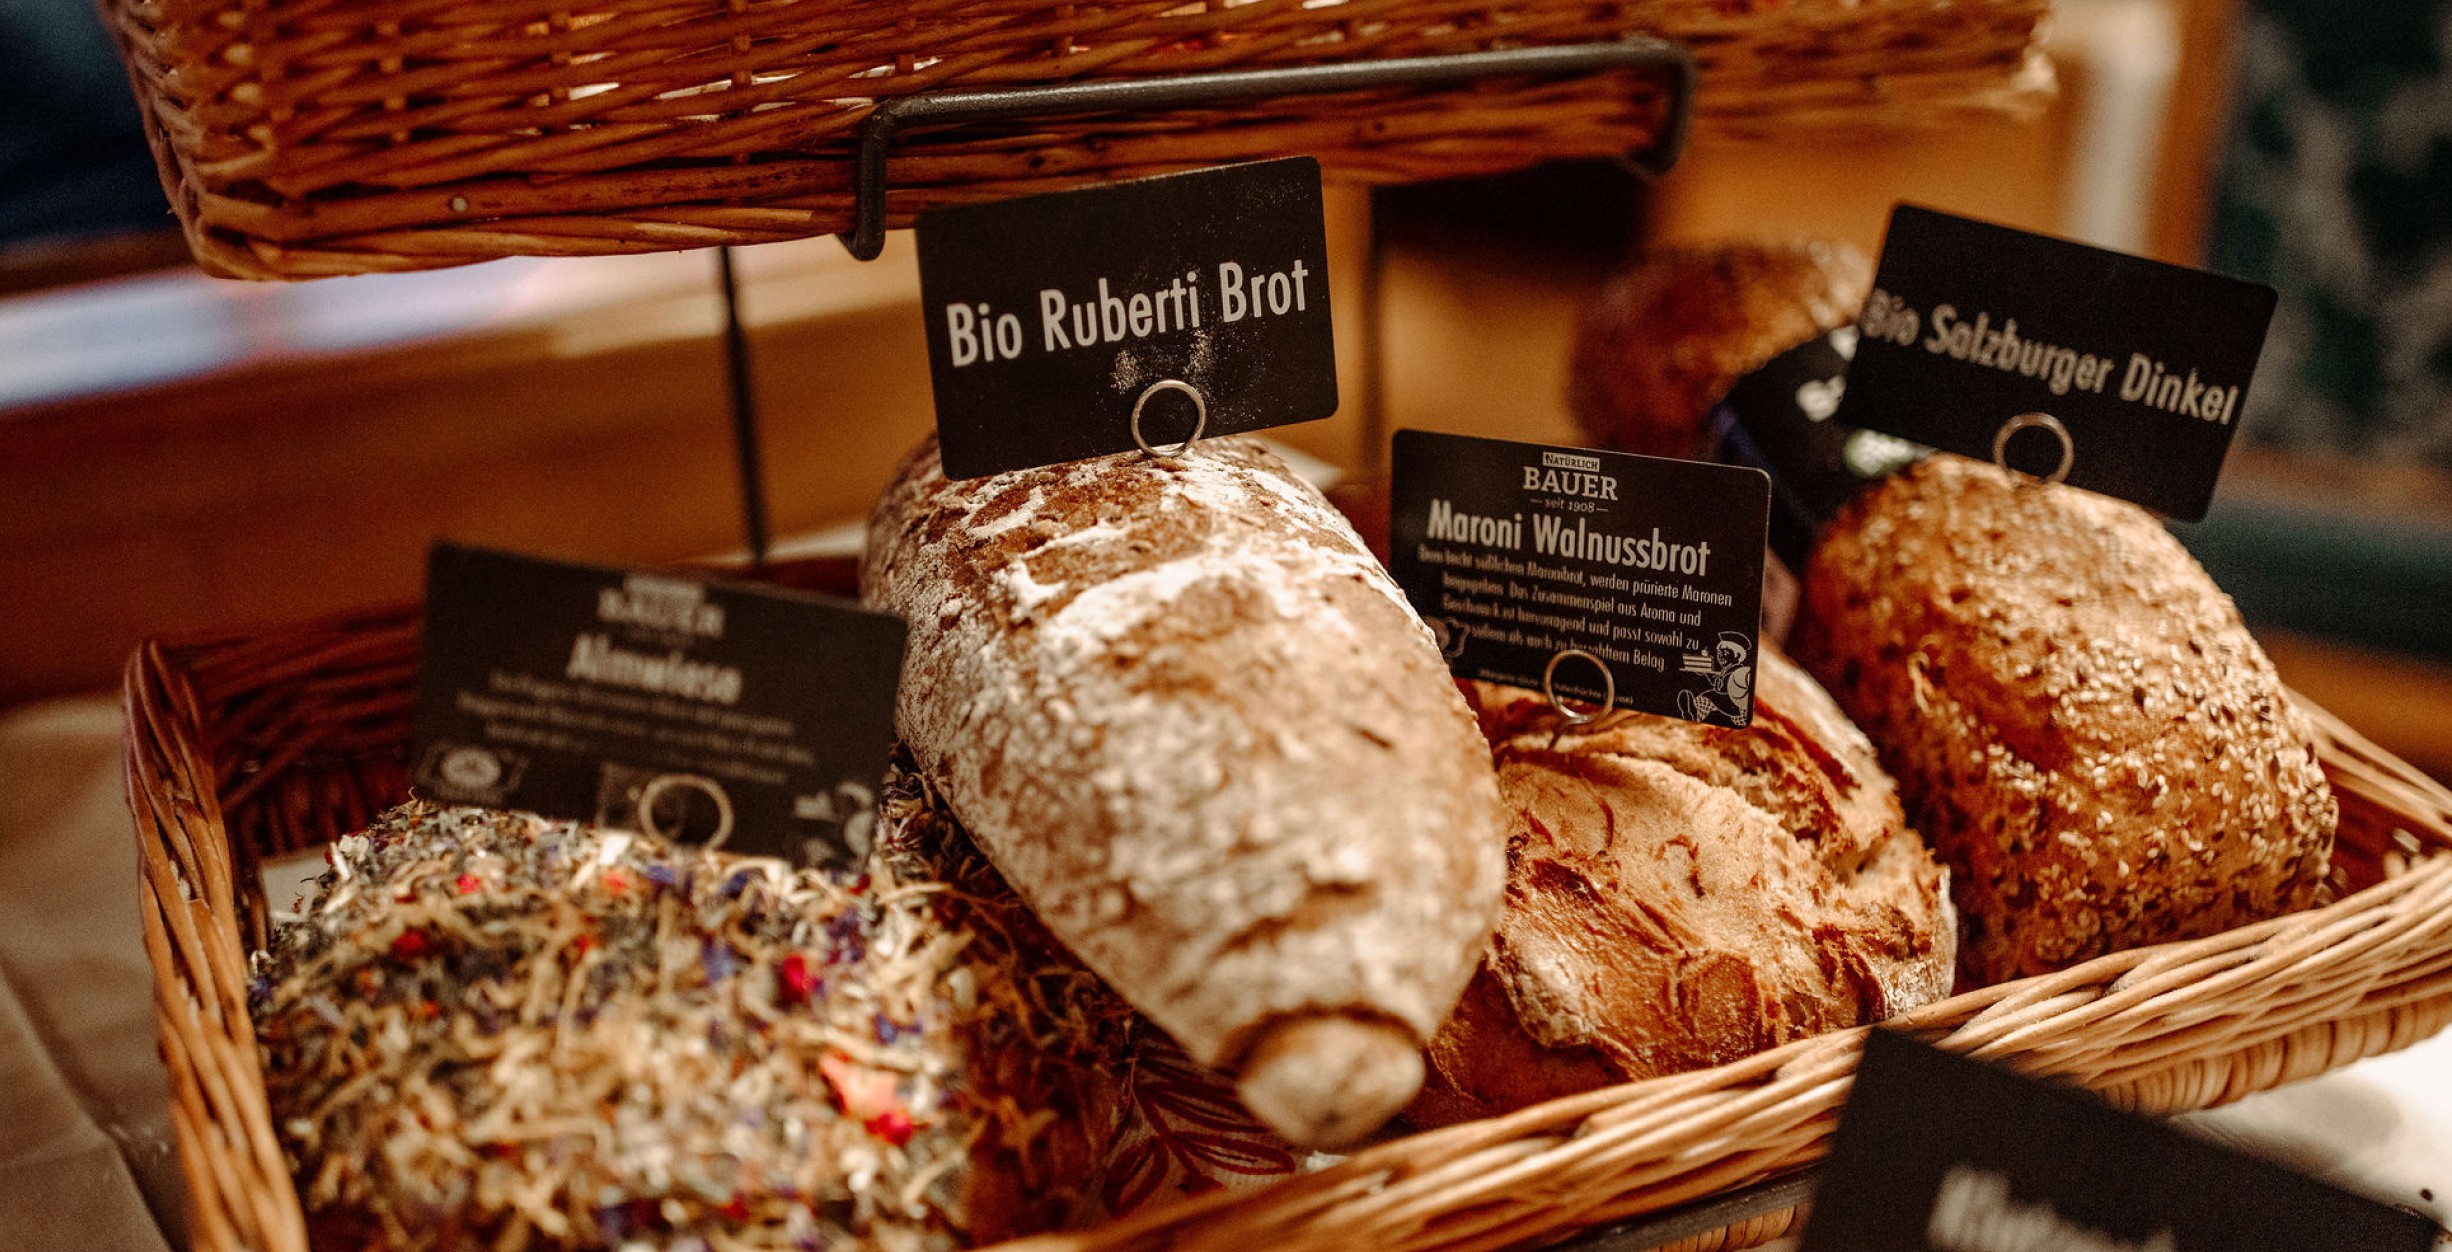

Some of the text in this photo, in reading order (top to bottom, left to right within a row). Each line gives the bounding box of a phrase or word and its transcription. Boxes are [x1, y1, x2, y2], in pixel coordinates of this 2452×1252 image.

[946, 259, 1309, 368] Bio Ruberti Brot
[1863, 288, 2239, 425] Bio Salzburger Dinkel
[1523, 466, 1618, 500] BAUER
[1568, 501, 1596, 513] 1908
[1426, 499, 1711, 577] Maroni Walnussbrot
[1590, 573, 1629, 592] werden
[1682, 584, 1732, 607] Maronen
[1617, 602, 1637, 617] aus
[1640, 602, 1675, 624] Aroma
[1679, 609, 1701, 627] und
[1588, 620, 1610, 637] und
[1613, 625, 1641, 641] passt
[1644, 627, 1683, 649] sowohl
[1687, 637, 1700, 651] zu
